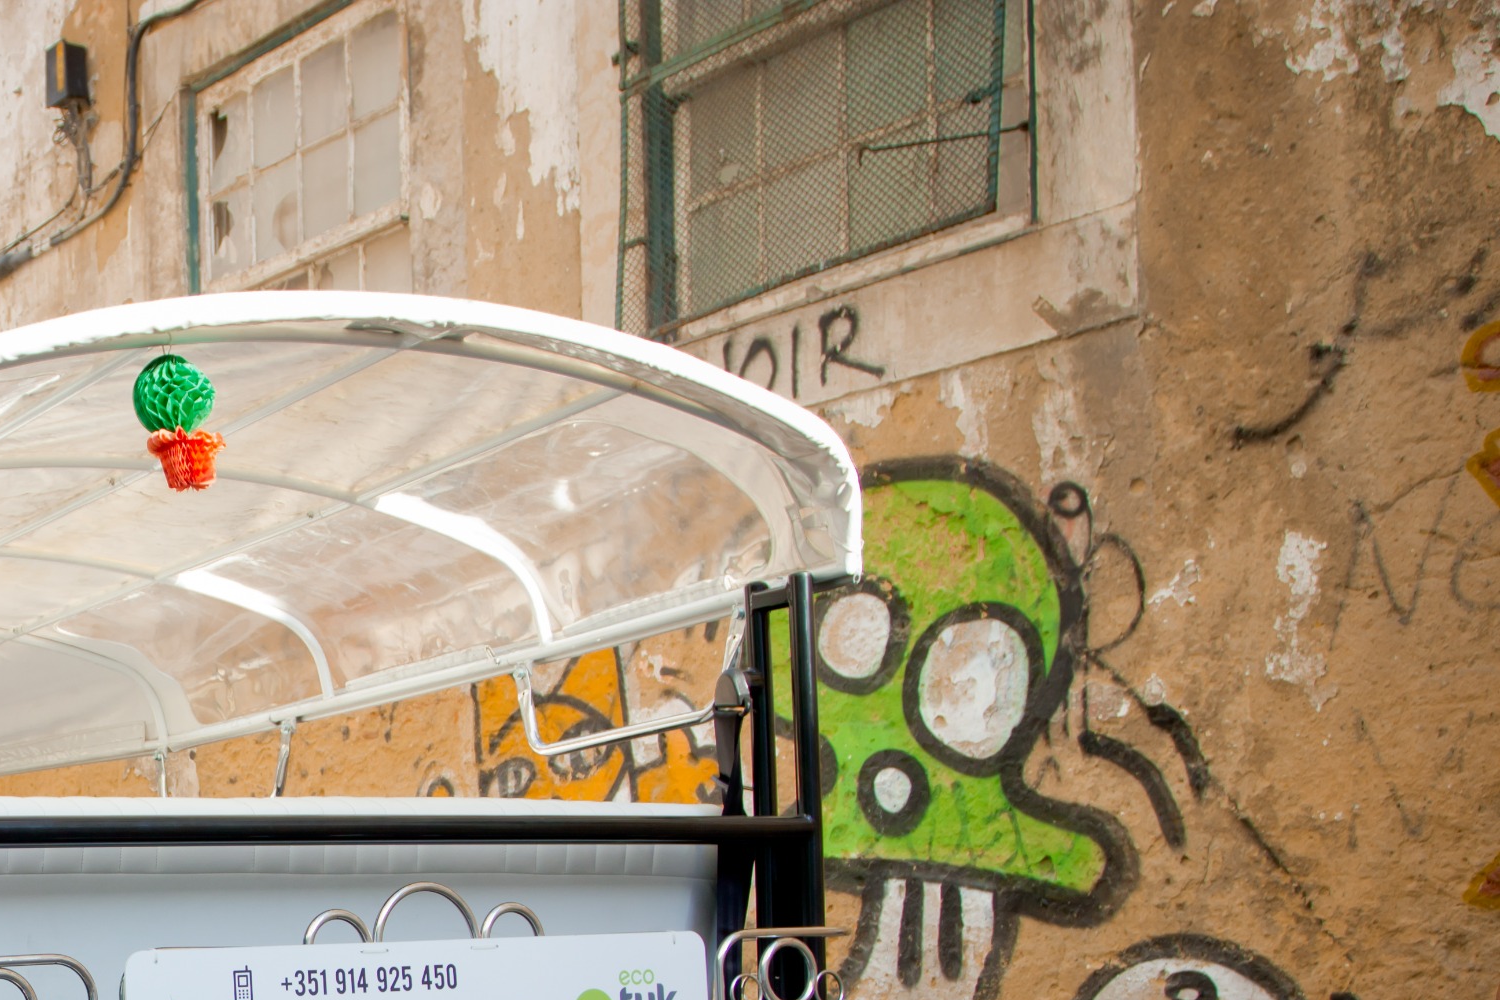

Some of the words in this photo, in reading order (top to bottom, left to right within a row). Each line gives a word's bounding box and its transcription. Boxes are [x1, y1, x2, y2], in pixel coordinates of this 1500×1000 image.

[281, 969, 328, 997] +351
[335, 967, 369, 995] 914
[376, 965, 413, 993] 925
[421, 963, 457, 991] 450
[619, 969, 655, 986] eco
